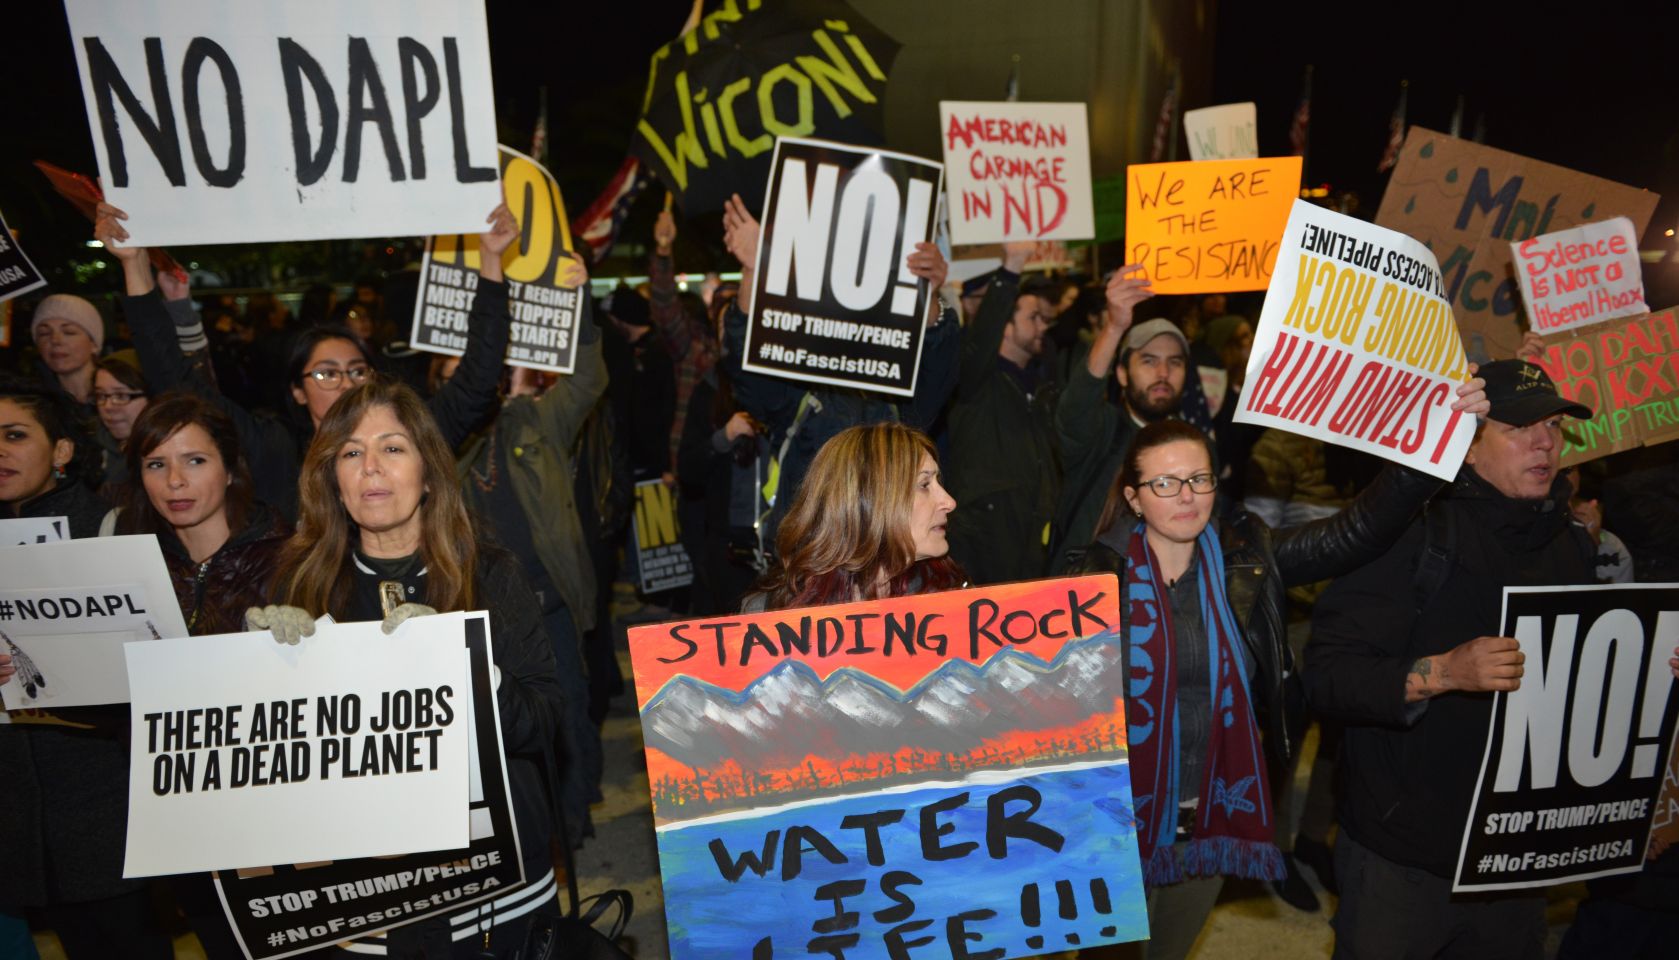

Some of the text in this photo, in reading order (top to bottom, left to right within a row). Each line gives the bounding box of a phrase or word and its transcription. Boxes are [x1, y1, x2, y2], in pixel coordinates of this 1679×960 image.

[82, 36, 247, 188] NO
[278, 35, 498, 184] DAPL
[947, 113, 1067, 150] AMERICAN
[969, 149, 1067, 184] CARNAGE
[962, 178, 1069, 238] IN ND
[1135, 168, 1271, 210] We ARE
[765, 158, 933, 317] NO!
[1157, 209, 1218, 235] THE
[1132, 238, 1278, 282] RESISTANC
[1300, 222, 1384, 272] PIPELINE!
[1519, 235, 1629, 276] Science
[430, 265, 462, 284] THIS
[524, 285, 577, 308] REGIME
[1383, 250, 1434, 290] ACCESS
[1554, 266, 1599, 296] NOT
[426, 284, 477, 311] MUST
[511, 303, 572, 329] TOPPED
[1283, 253, 1473, 383] TANDING ROCK
[1595, 287, 1645, 315] Hoax
[424, 305, 569, 350] BEFO STARTS
[761, 309, 912, 350] STOP TRUMP/PENCE
[759, 343, 901, 380] #NoFascistUSA
[1526, 340, 1595, 382] NO
[1245, 331, 1465, 465] I STAND WITH
[0, 593, 146, 621] #NODAPL
[656, 611, 949, 668] STANDING
[144, 685, 455, 754] THERE ARE NO JOBS
[1493, 608, 1679, 793] NO!
[152, 729, 444, 796] ON A DEAD PLANET
[707, 785, 1066, 882] WATER
[1484, 798, 1650, 835] STOP TRUMP/PENCE
[1477, 838, 1634, 874] #NoFascistUSA
[248, 888, 319, 918] STOP
[320, 850, 502, 904] TRUMP/PENCE
[812, 870, 924, 934] IS
[266, 876, 501, 947] #NoFascistUSA
